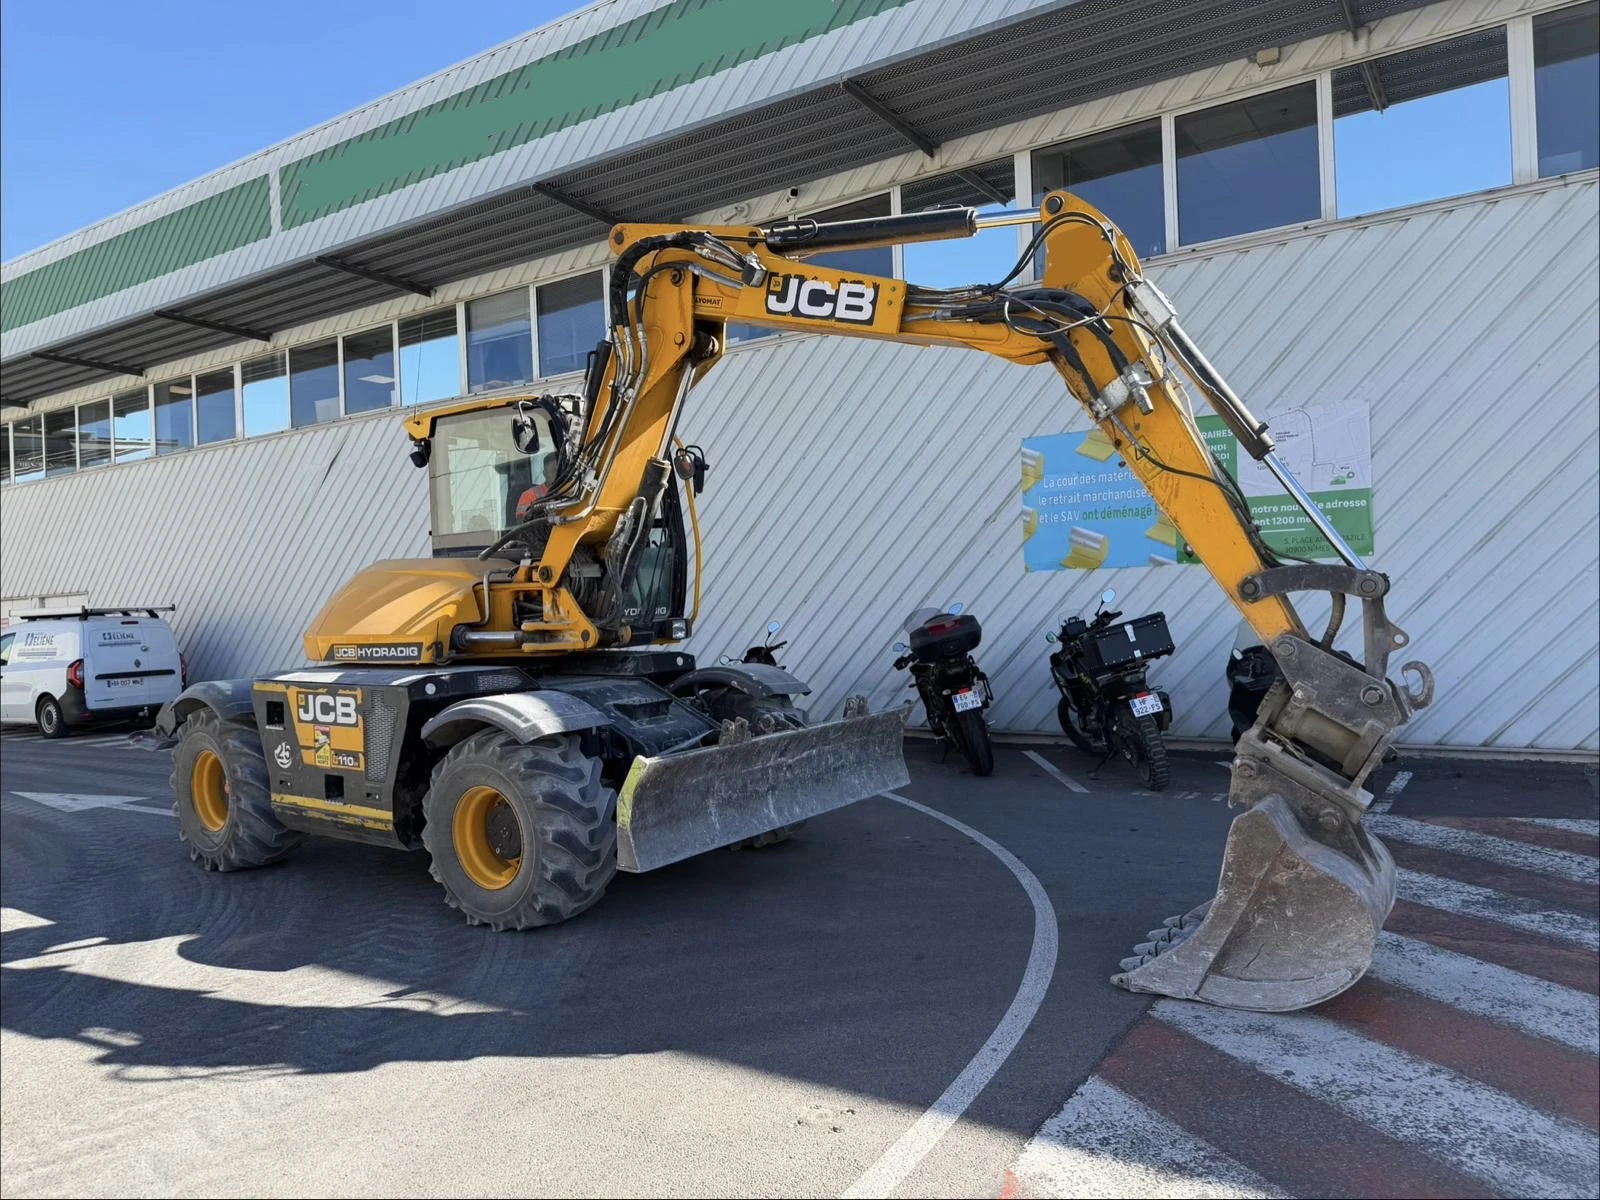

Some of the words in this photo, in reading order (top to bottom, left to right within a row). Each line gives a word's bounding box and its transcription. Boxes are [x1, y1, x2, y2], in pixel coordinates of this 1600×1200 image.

[767, 278, 875, 321] JCB
[1202, 429, 1233, 439] RAIRES
[1043, 477, 1055, 488] La
[1057, 476, 1077, 487] cour
[1080, 474, 1096, 484] des
[1098, 470, 1137, 483] matéria
[1038, 495, 1047, 506] le
[1049, 492, 1081, 505] retrait
[1039, 513, 1049, 524] et
[1051, 512, 1058, 522] le
[1061, 510, 1080, 522] SAV
[1082, 509, 1098, 521] ont
[1100, 503, 1153, 520] déménagé
[1251, 504, 1278, 514] notre
[1325, 499, 1368, 509] adresse
[1272, 516, 1295, 525] 1200
[336, 647, 356, 657] JCB
[357, 646, 418, 657] HYDRADIG
[298, 694, 357, 724] JCB
[338, 755, 354, 767] 110
